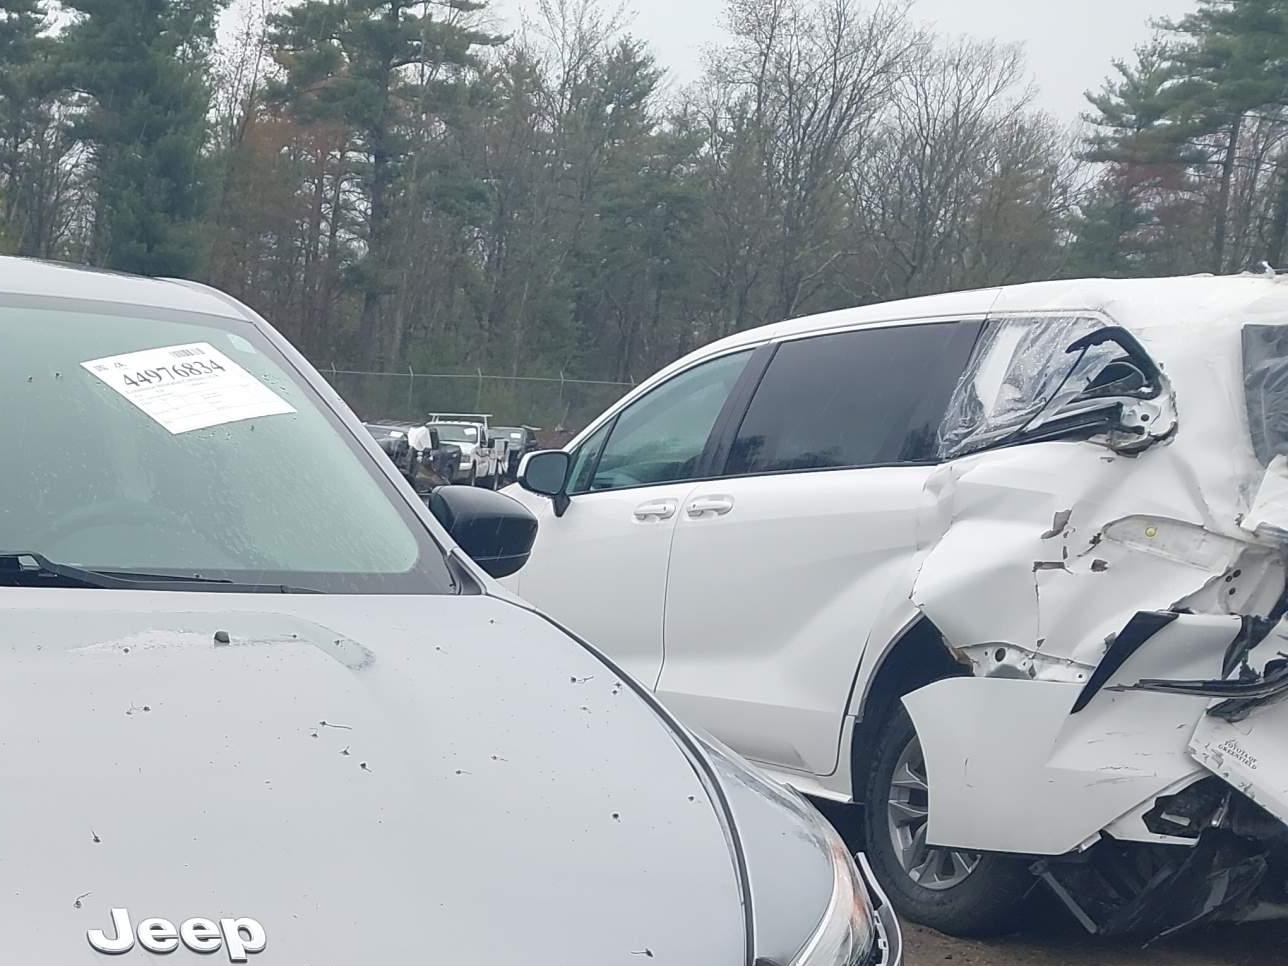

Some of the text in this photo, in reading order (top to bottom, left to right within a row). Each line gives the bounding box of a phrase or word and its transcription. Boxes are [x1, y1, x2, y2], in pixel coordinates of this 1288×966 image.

[122, 359, 226, 388] 44976834
[1218, 744, 1257, 770] GREENFIELD
[1224, 739, 1249, 759] TOYOTA
[87, 907, 267, 963] Jeep
